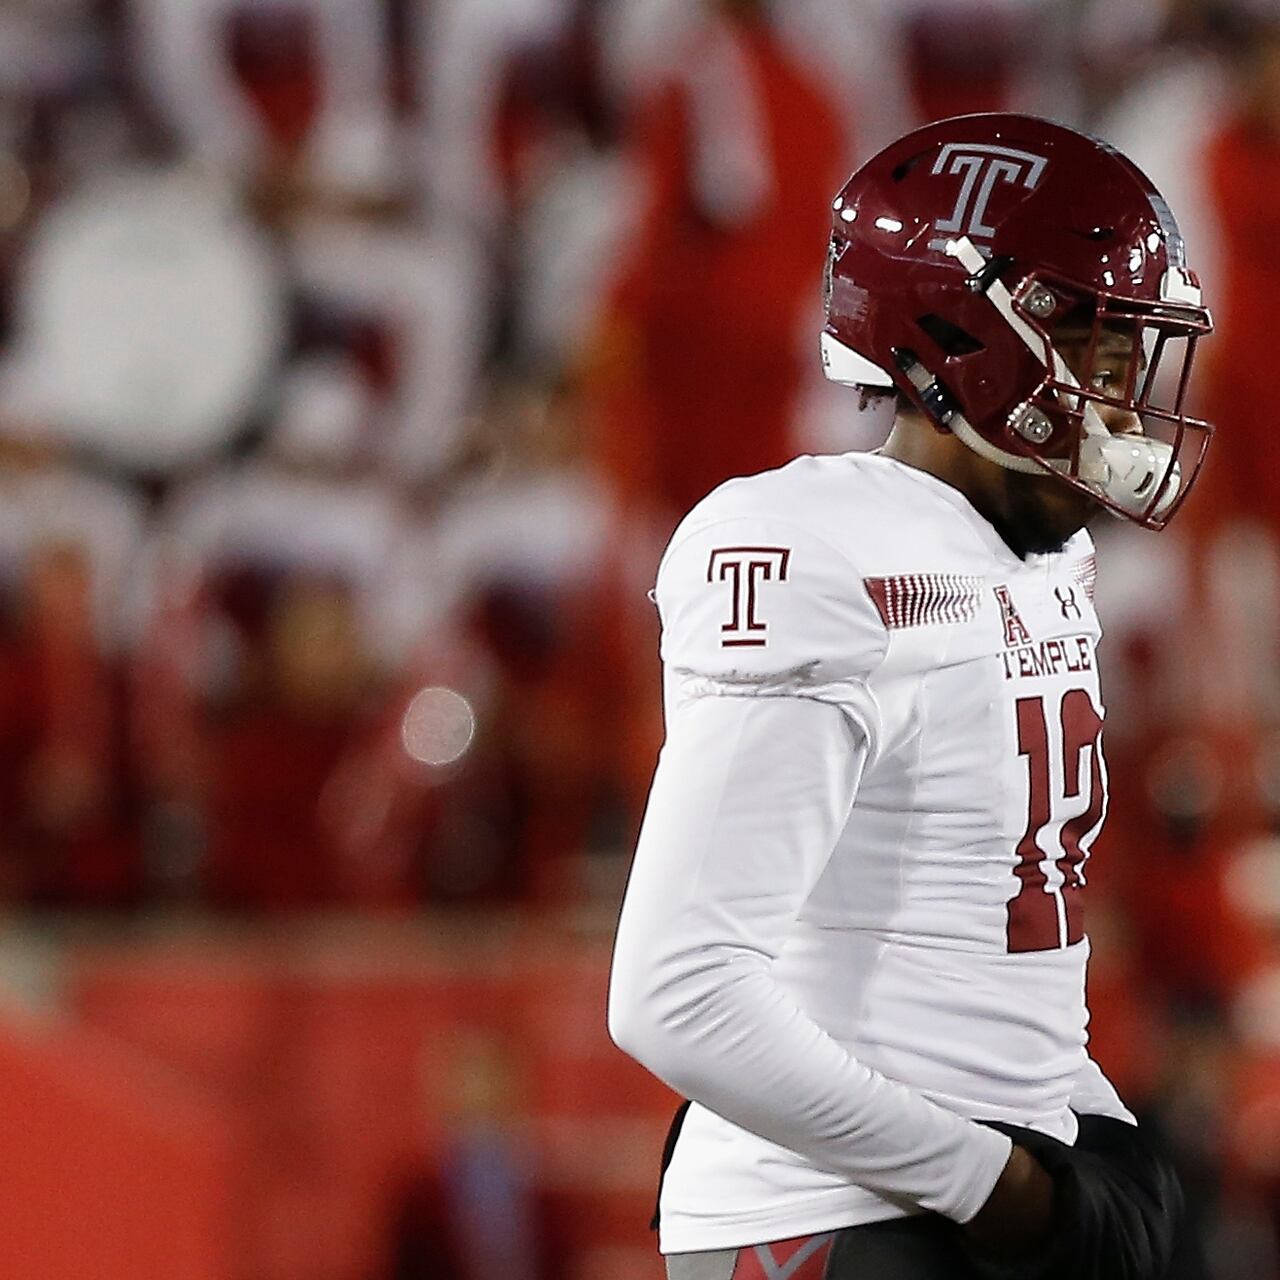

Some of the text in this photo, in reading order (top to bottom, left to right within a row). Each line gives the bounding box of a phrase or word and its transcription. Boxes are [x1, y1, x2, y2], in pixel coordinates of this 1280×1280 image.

[706, 545, 793, 648] T
[996, 637, 1092, 679] TEMPLE
[1006, 689, 1107, 954] 12
